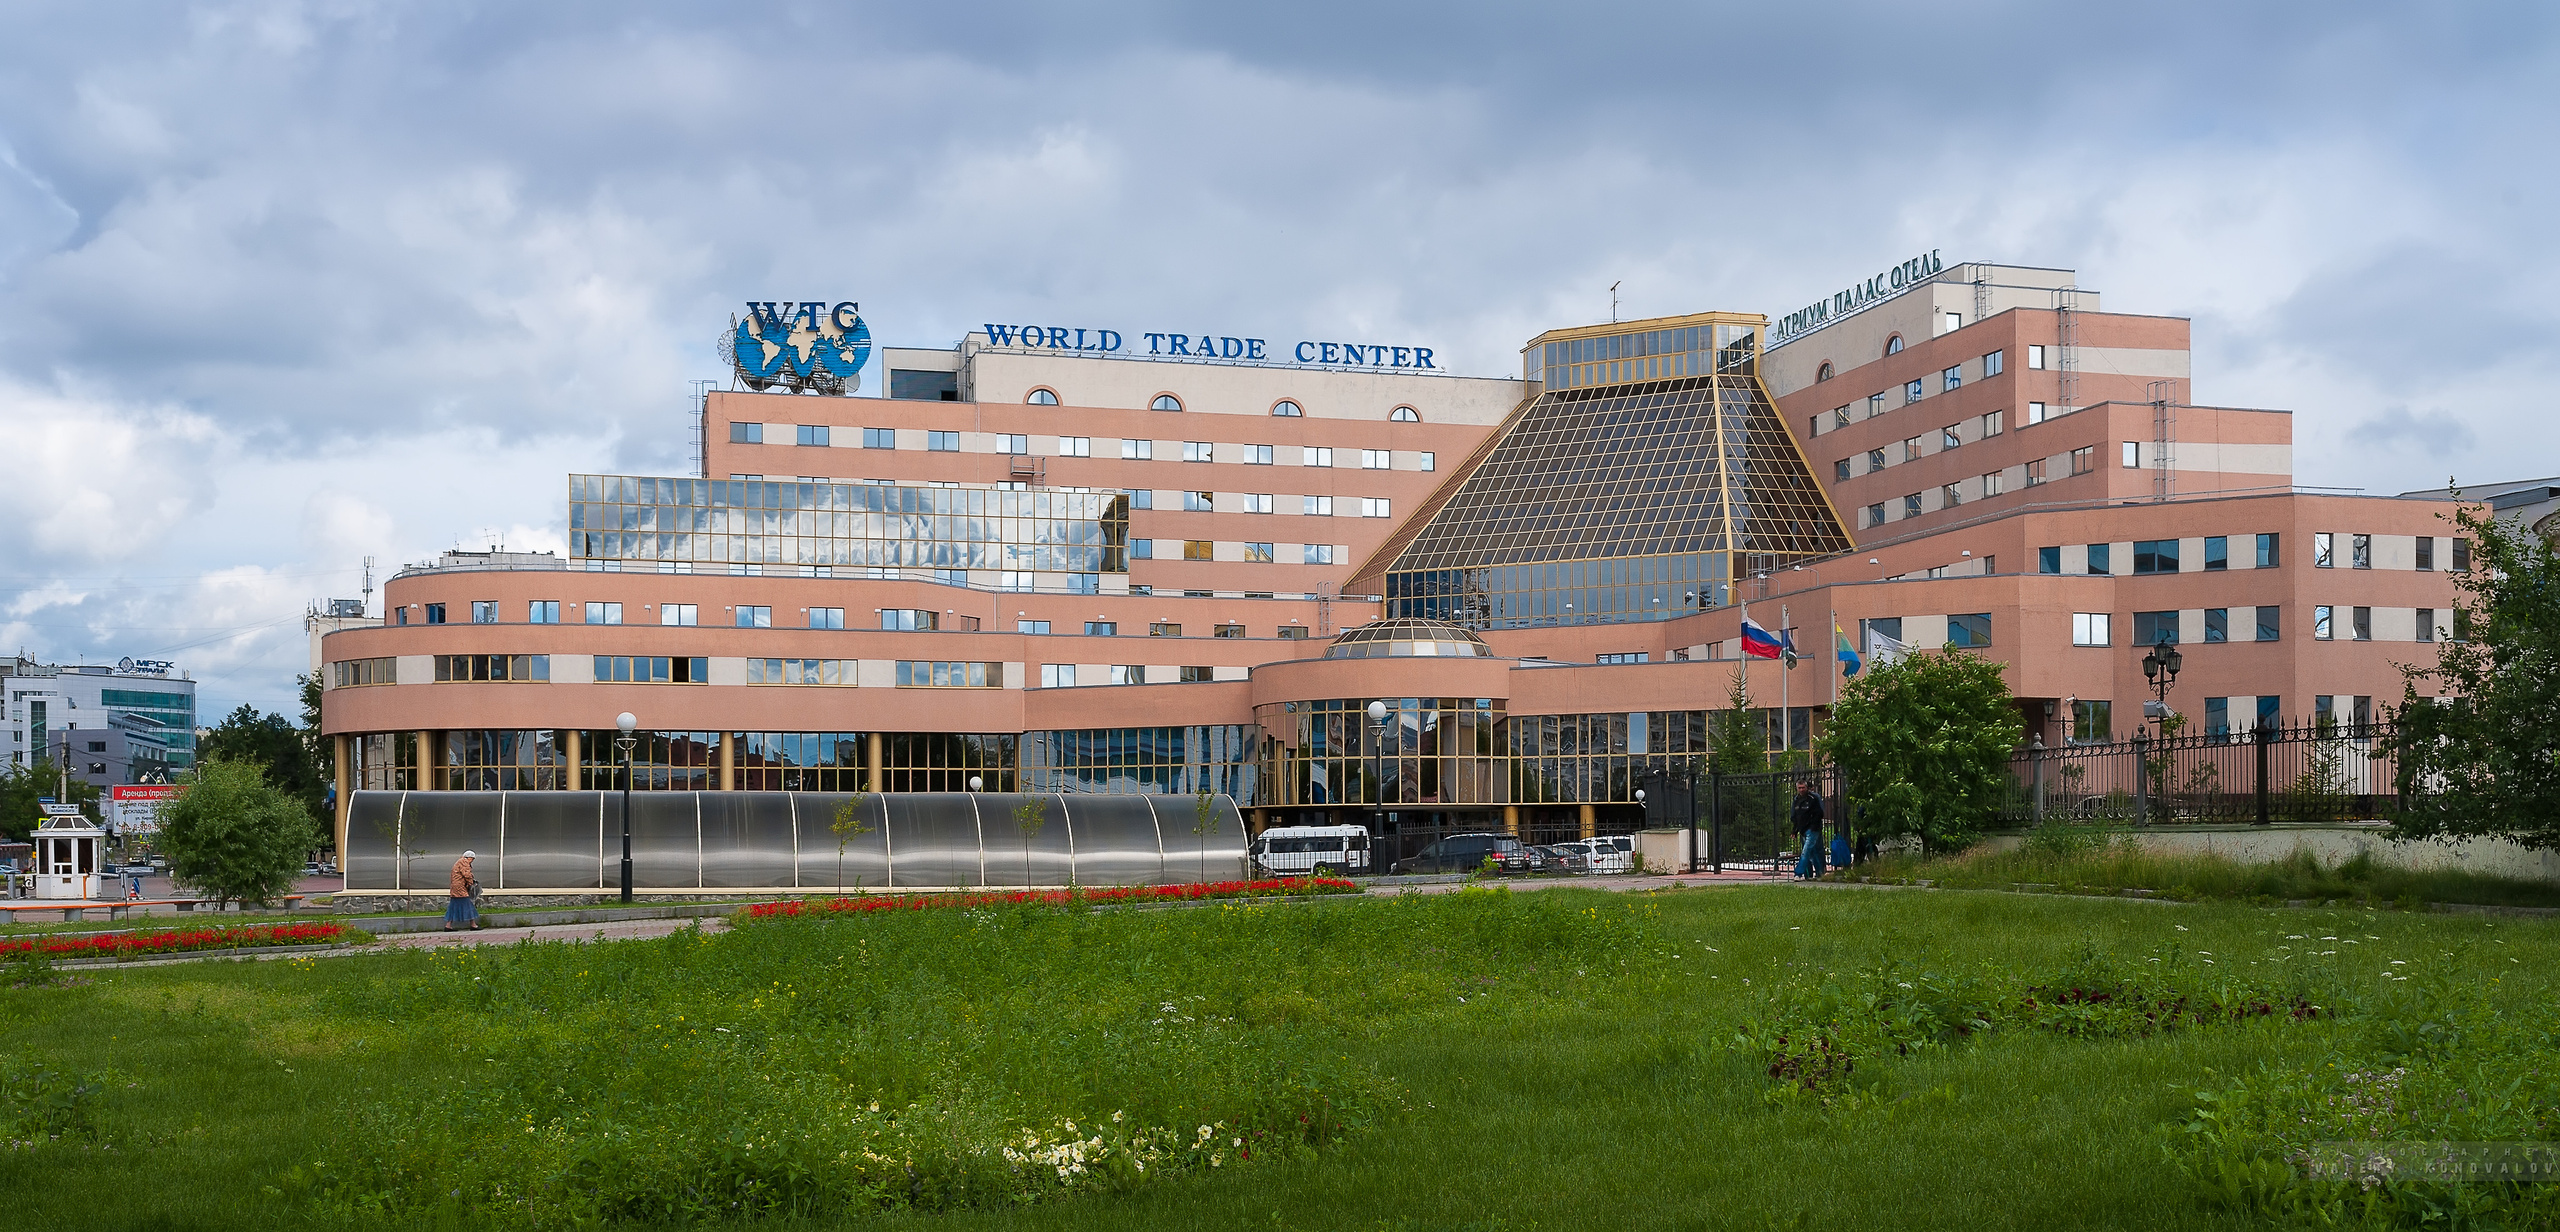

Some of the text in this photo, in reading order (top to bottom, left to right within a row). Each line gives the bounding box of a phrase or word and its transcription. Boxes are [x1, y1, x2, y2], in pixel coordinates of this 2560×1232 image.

[1776, 249, 1943, 340] АТРИУМ ПАЛАС ОТЕЛЬ
[746, 301, 859, 332] WTC
[984, 323, 1436, 368] WORLD TRADE CENTER
[136, 659, 175, 669] МРСК
[121, 789, 148, 797] Аренда
